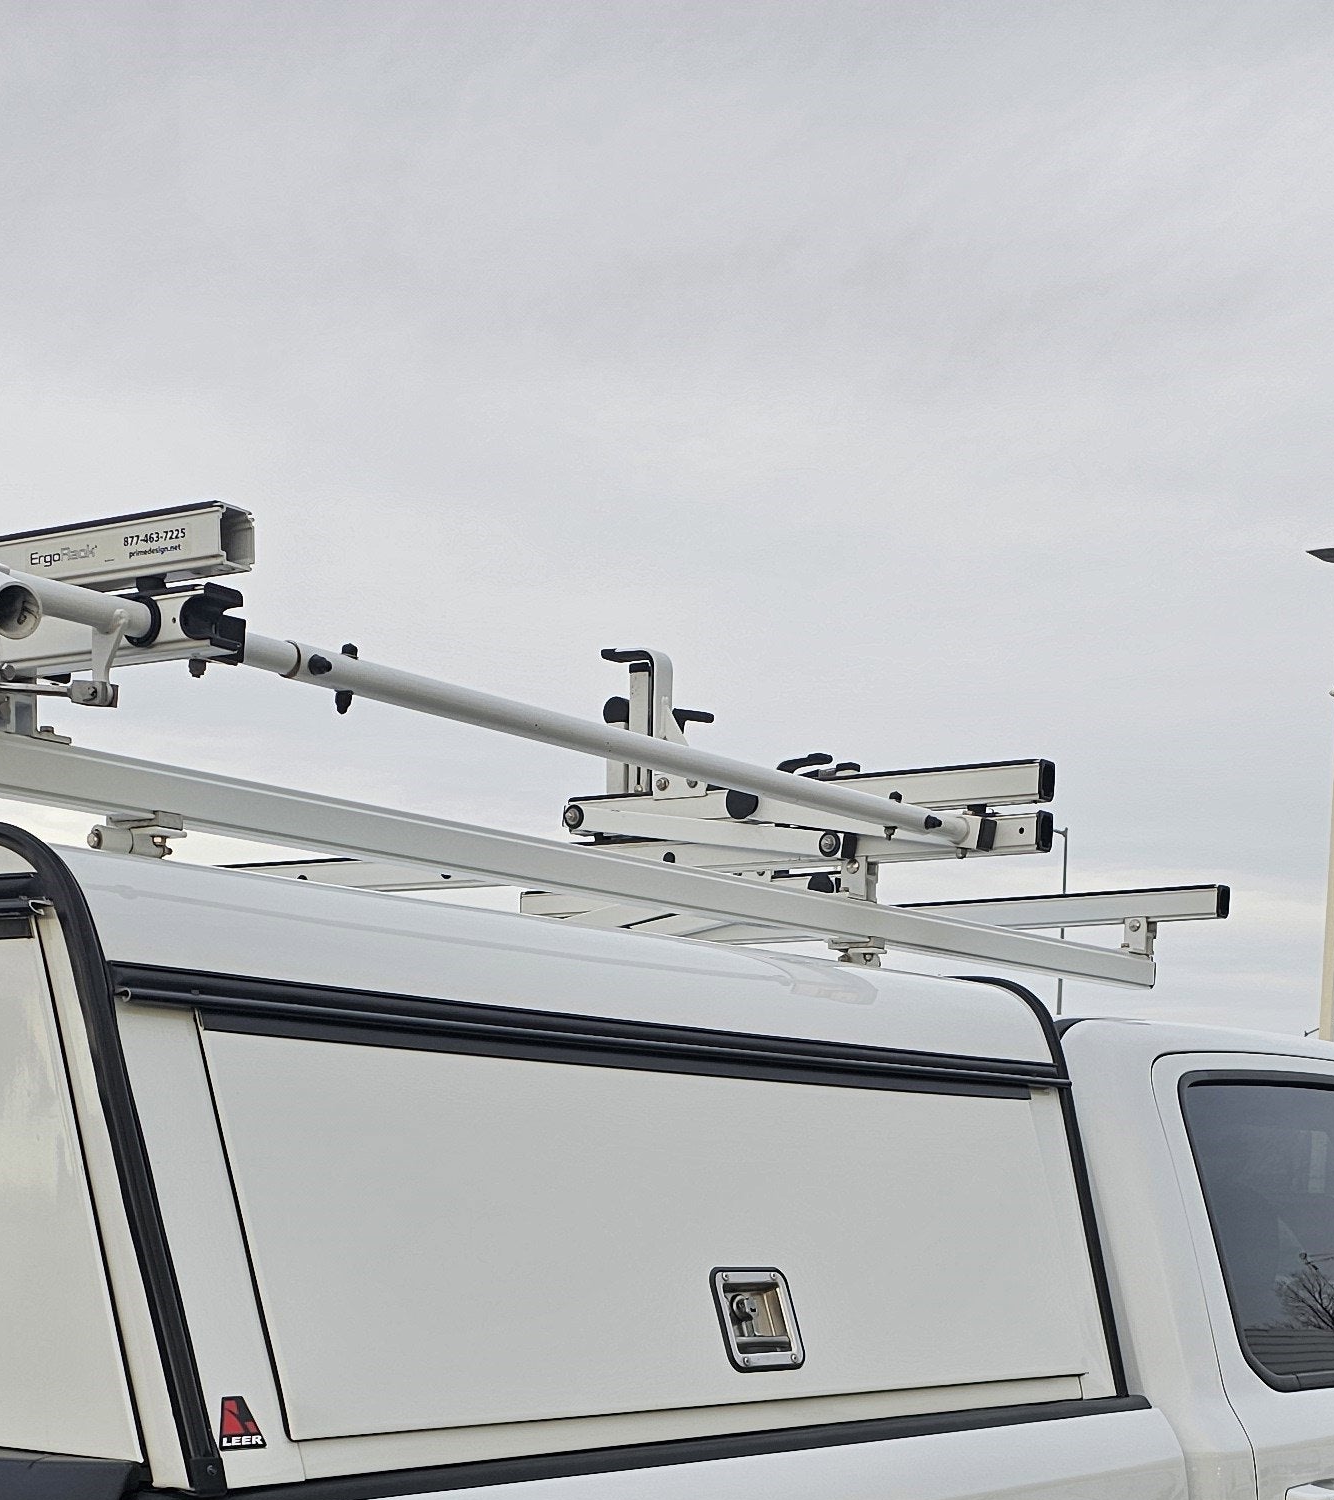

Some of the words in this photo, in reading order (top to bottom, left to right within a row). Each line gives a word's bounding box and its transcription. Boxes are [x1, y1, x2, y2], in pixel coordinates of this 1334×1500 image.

[123, 528, 186, 547] 877-463-7225
[30, 544, 95, 567] ErgoRack
[128, 543, 181, 559] primedesign.net
[222, 1435, 263, 1447] LEER
